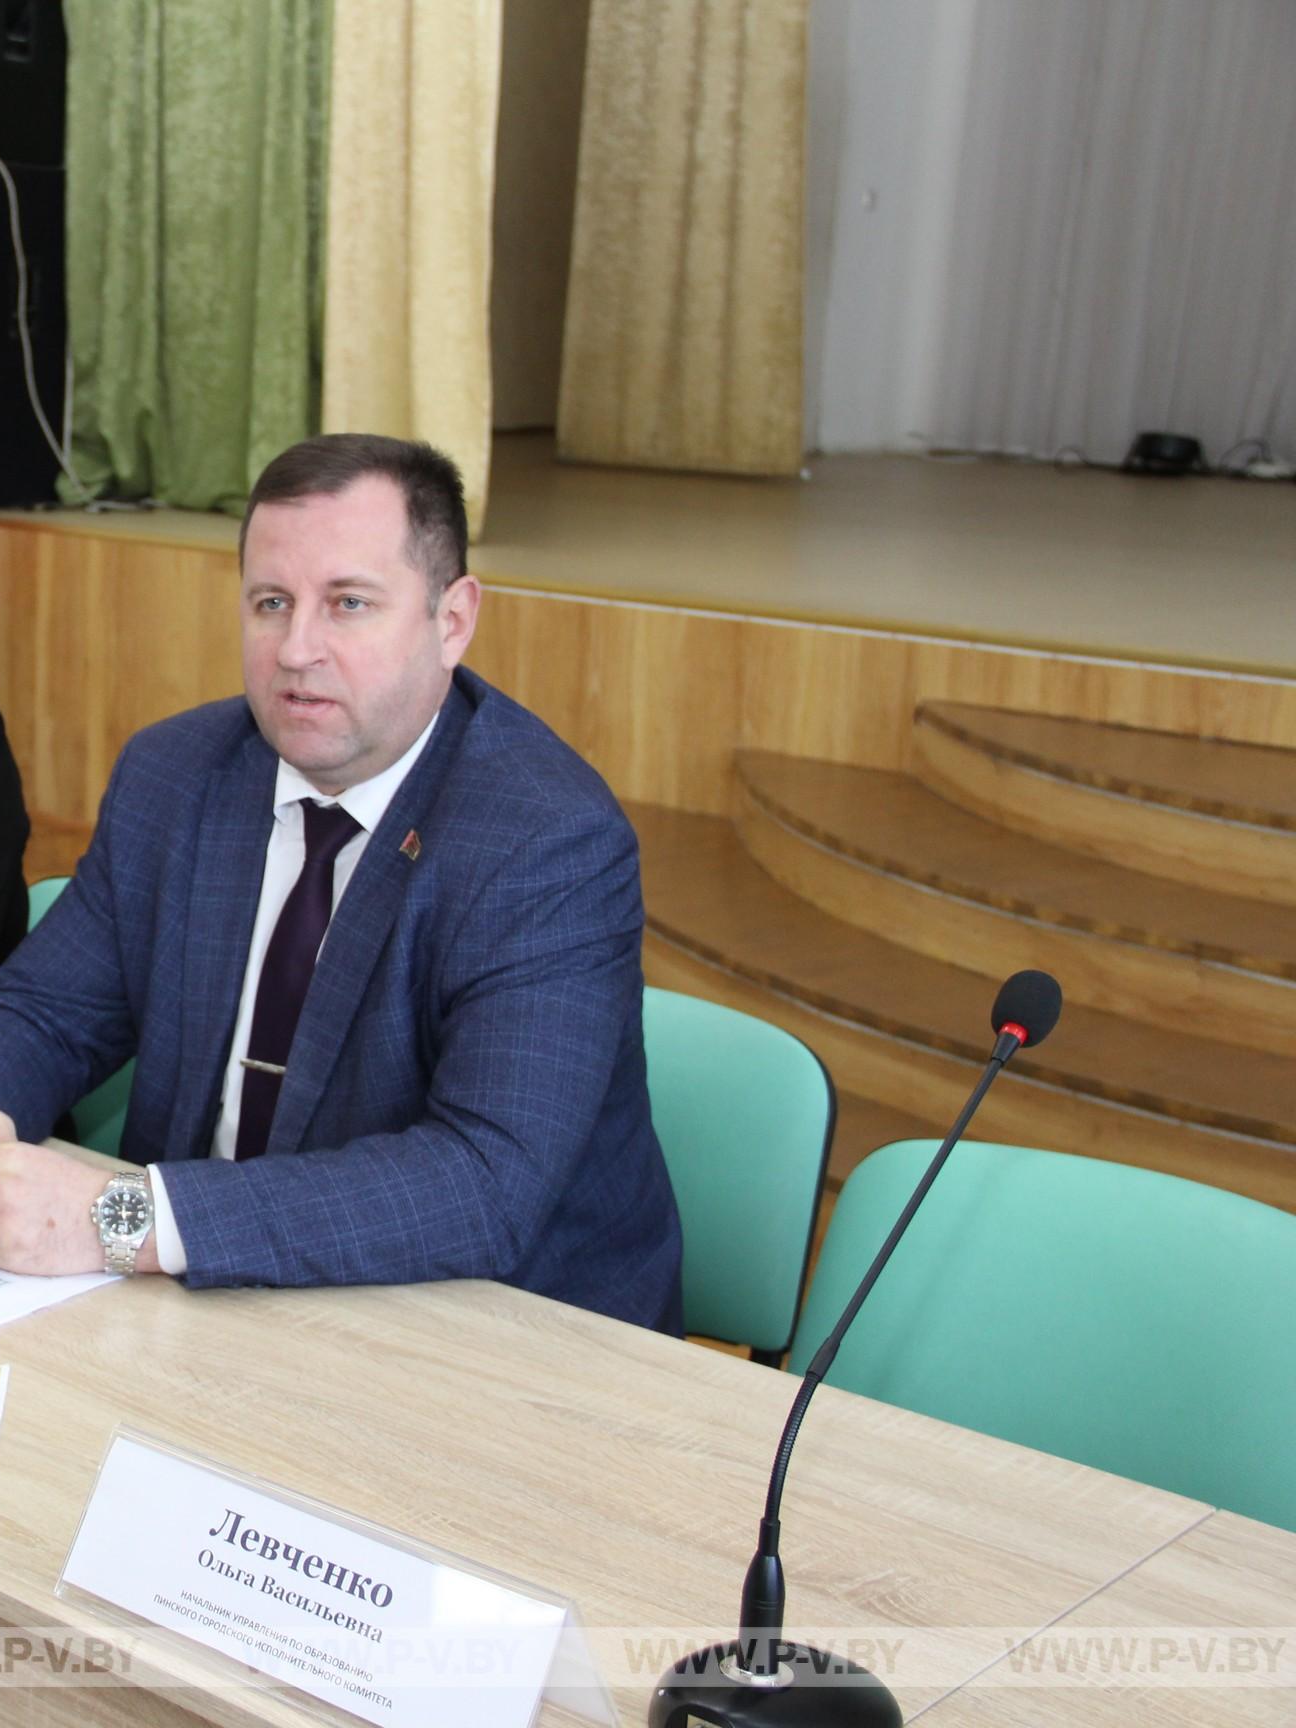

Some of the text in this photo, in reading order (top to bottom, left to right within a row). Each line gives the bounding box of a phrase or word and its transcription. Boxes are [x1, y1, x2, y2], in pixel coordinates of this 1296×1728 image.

[198, 1549, 383, 1643] Ольга Васильевна
[209, 1508, 393, 1608] Левченко
[153, 1594, 393, 1710] ПИНСКОГО ГОРОДСКОГО ИСПОЛНИТЕЛЬНОГО КОМИТЕТА
[180, 1590, 373, 1682] НАЧАЛЬНИК УПРАВЛЕНИЯ ПО ОБРАЗОВАНИЮ
